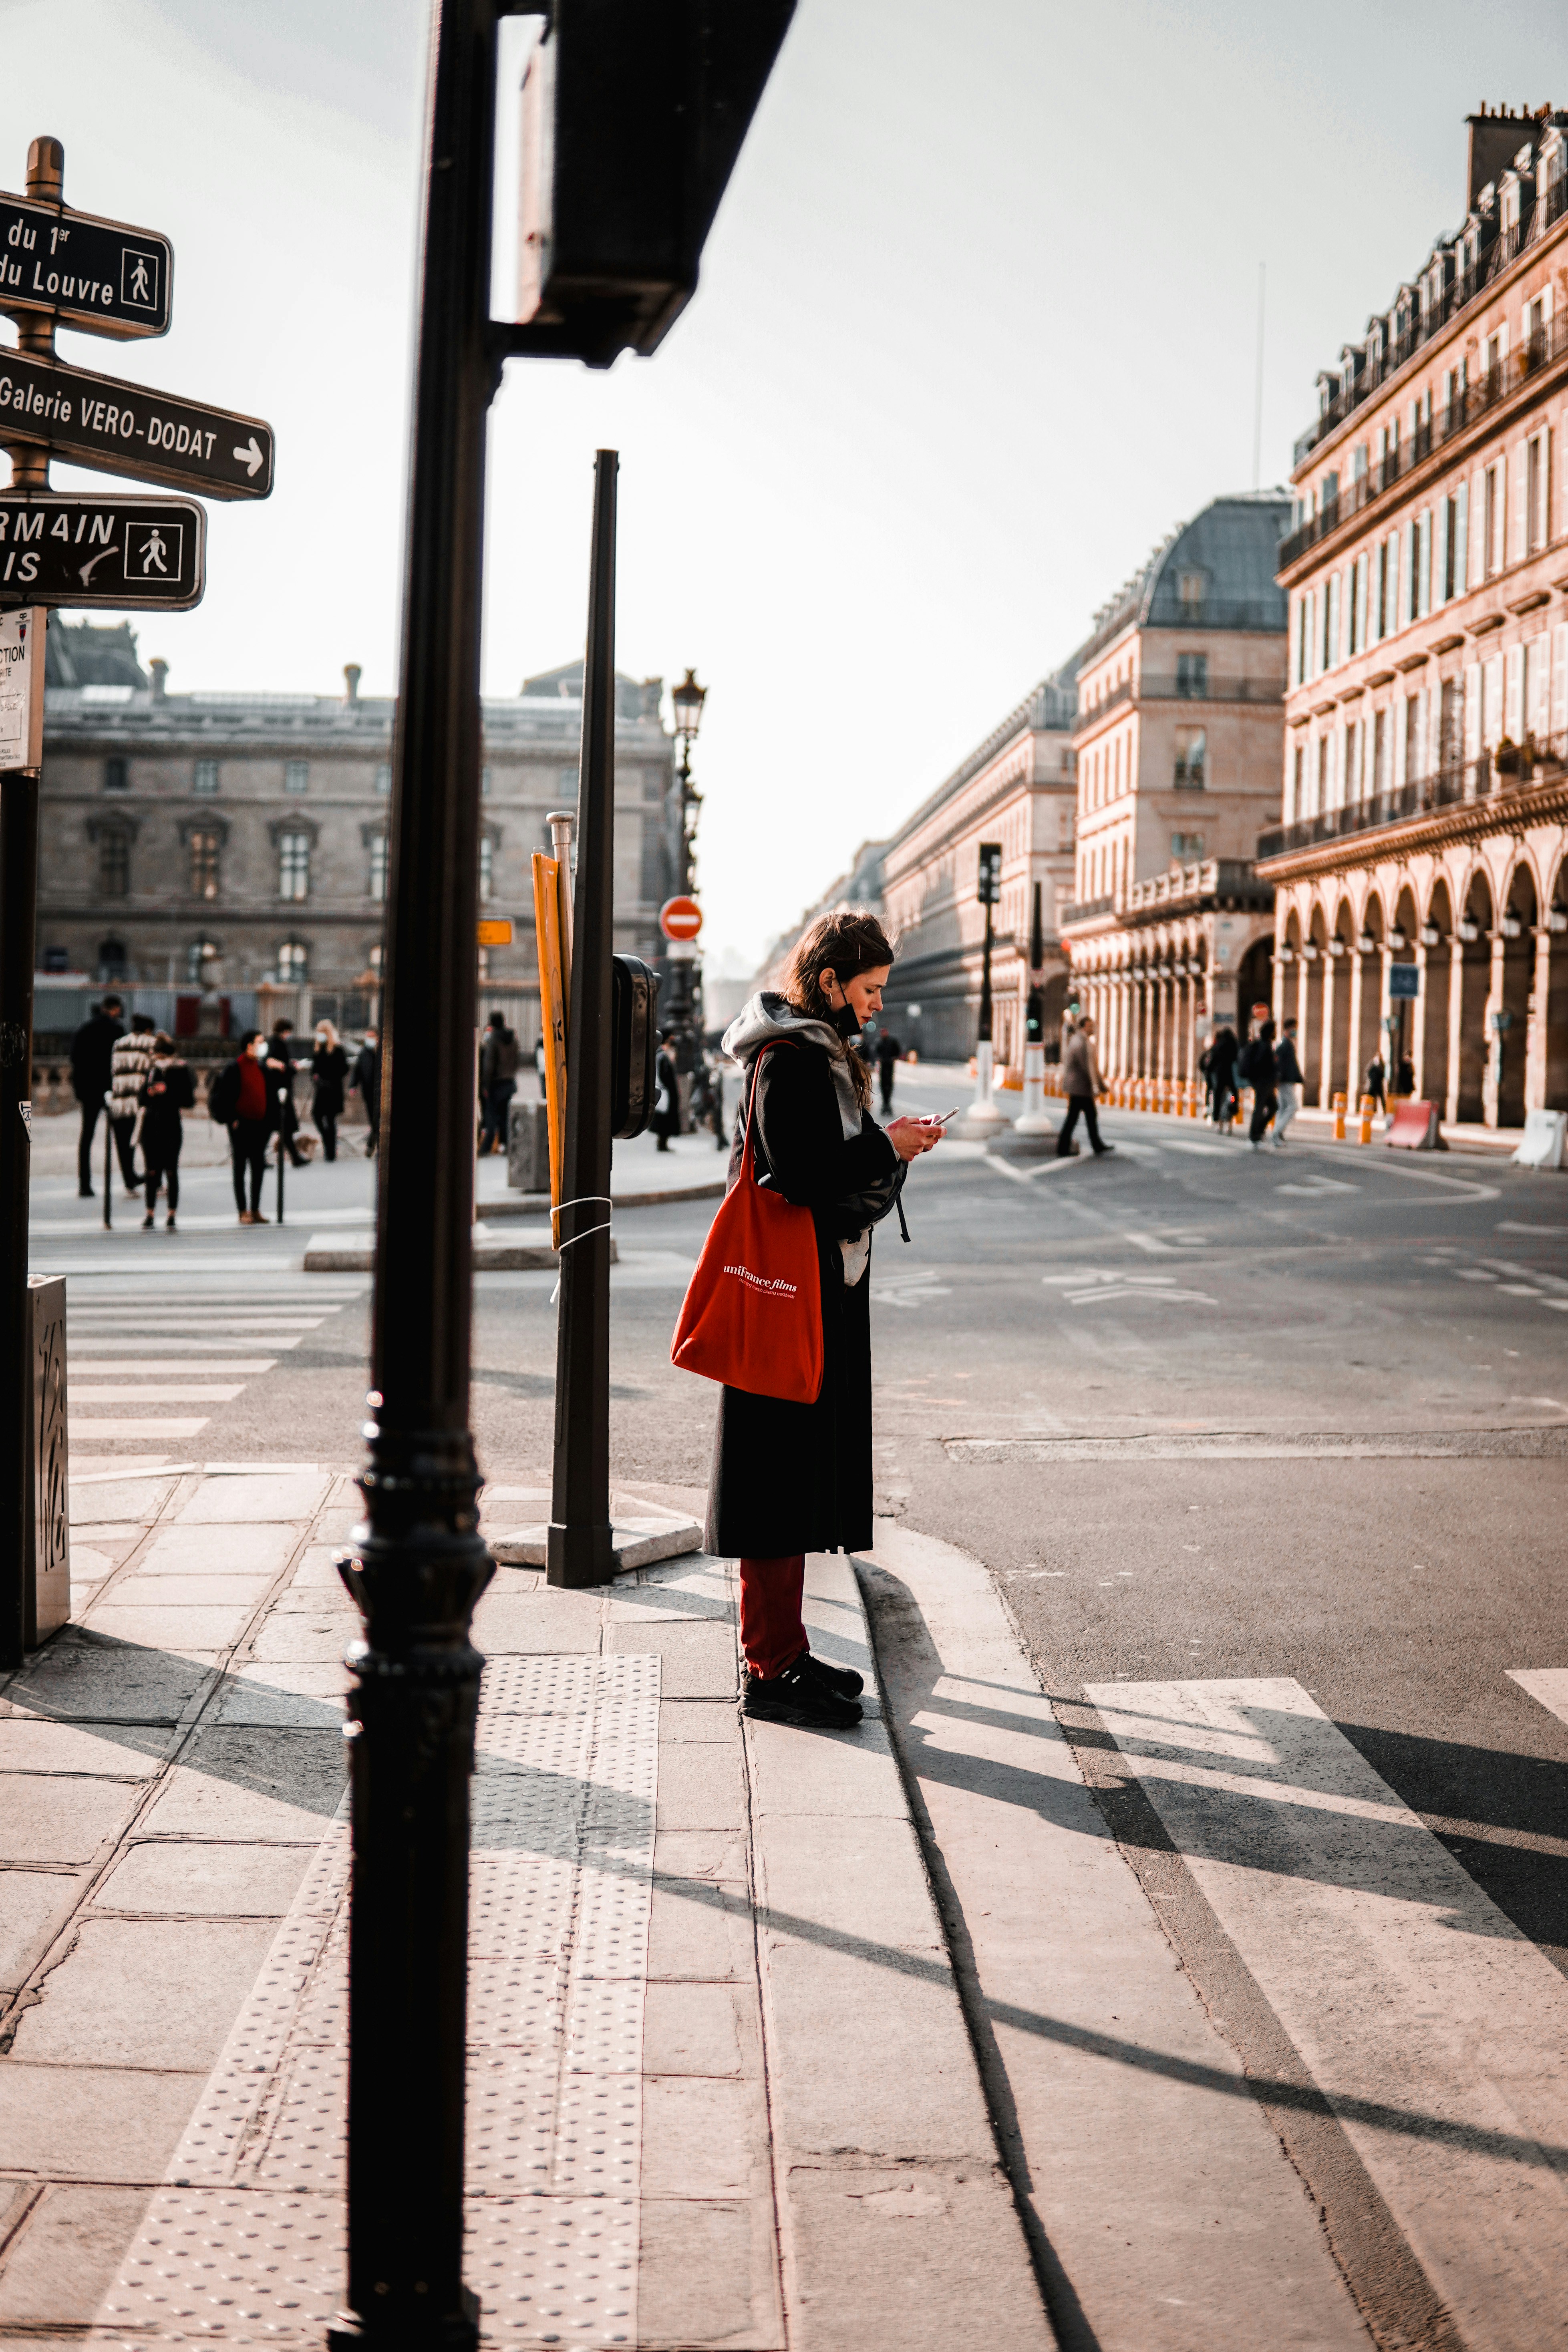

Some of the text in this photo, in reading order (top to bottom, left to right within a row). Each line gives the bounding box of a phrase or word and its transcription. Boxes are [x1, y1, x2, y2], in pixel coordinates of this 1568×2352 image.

[8, 218, 71, 255] du 1er
[33, 261, 114, 306] Louvre
[0, 376, 217, 460] Galerie VERO-DODAT
[3, 551, 41, 581] IS
[769, 1279, 797, 1292] films
